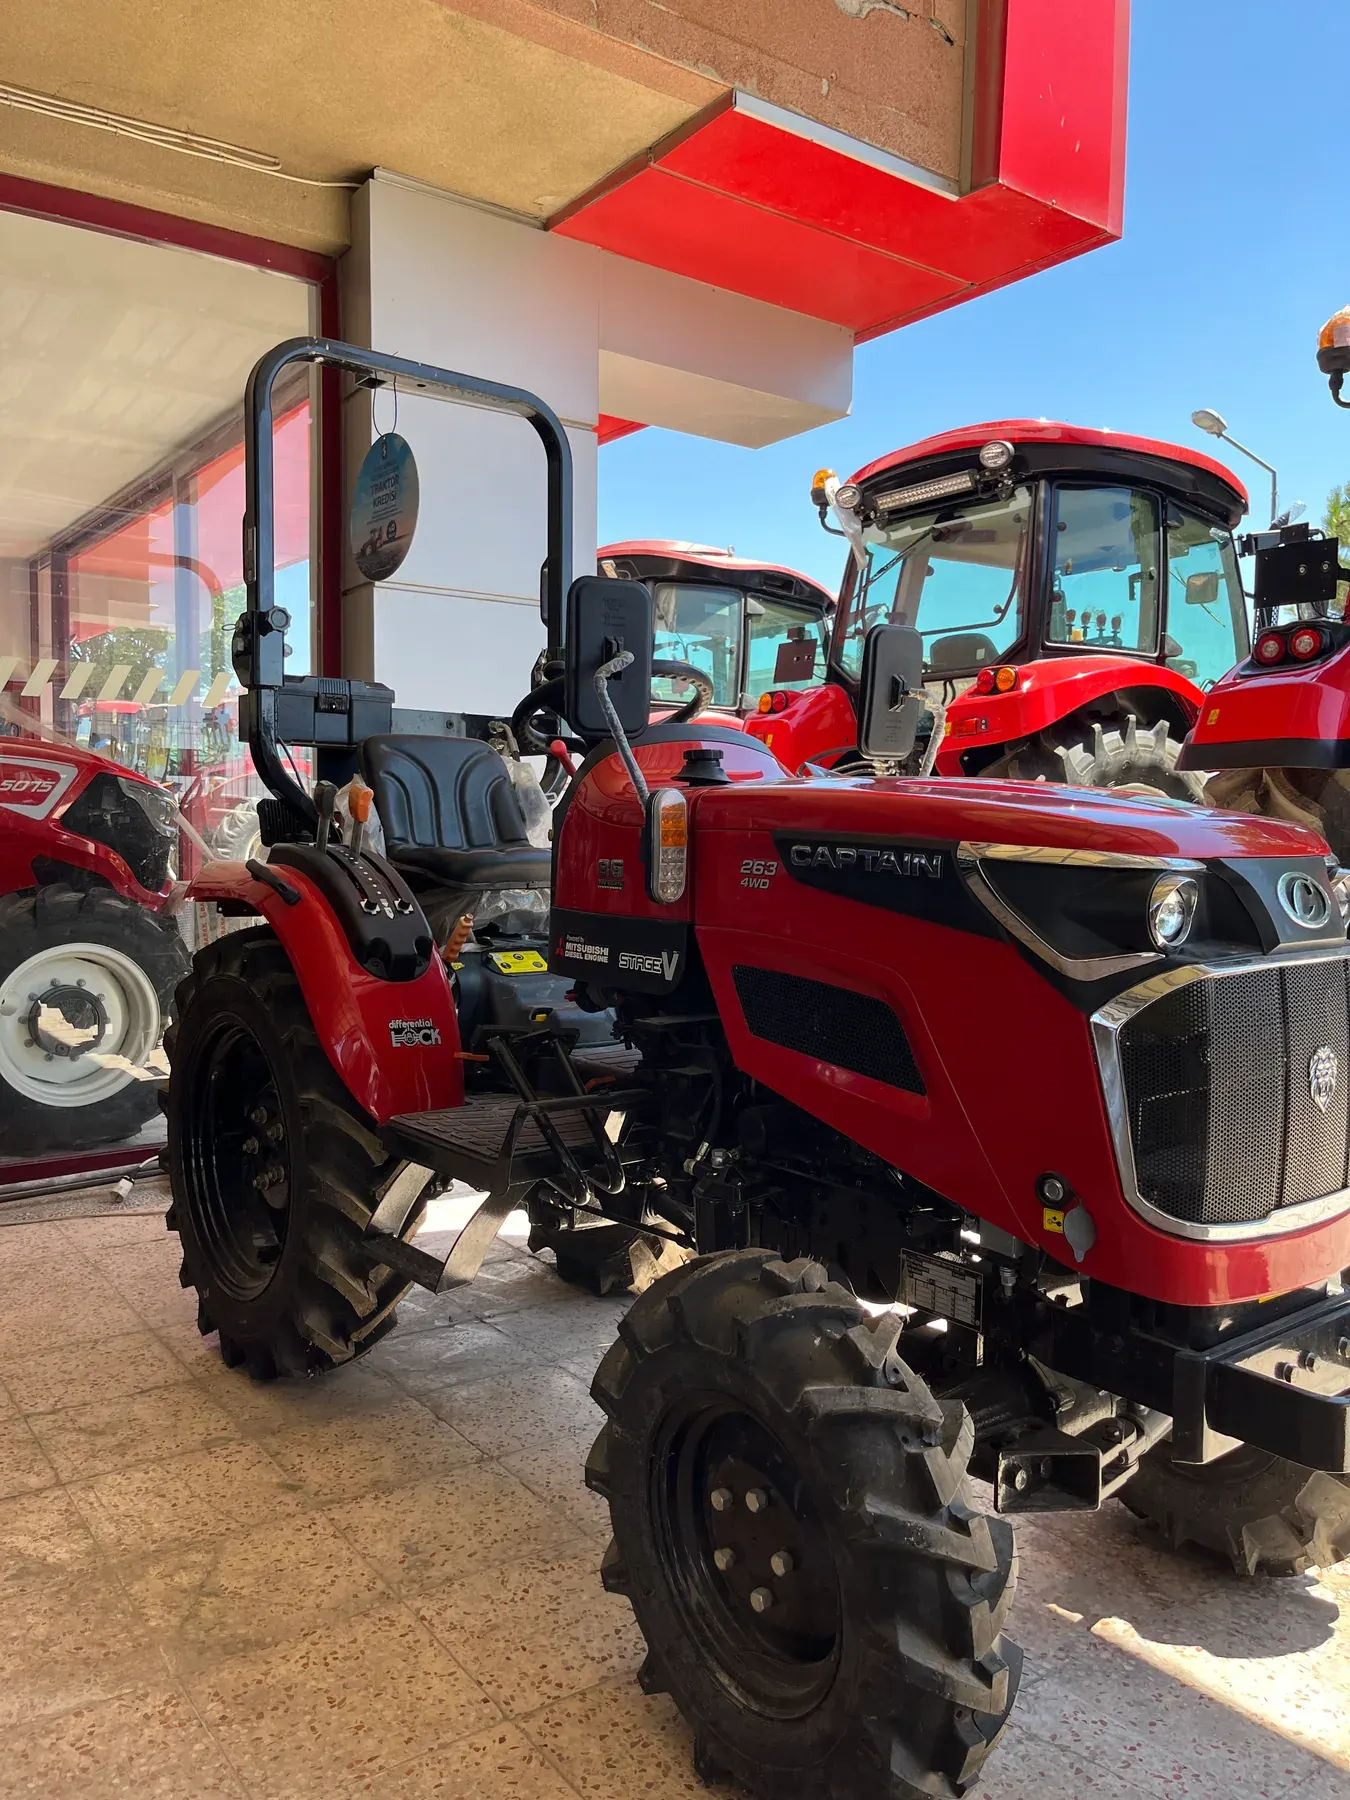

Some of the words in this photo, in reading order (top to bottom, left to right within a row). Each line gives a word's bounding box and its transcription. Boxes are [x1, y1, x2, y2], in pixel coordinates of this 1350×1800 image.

[0, 780, 56, 793] 5075
[740, 859, 777, 876] 263
[790, 845, 942, 879] CAPTAIN
[740, 877, 770, 890] 4WD
[565, 942, 609, 956] MITSUBISHI
[564, 950, 583, 960] DIESEL
[584, 953, 609, 964] ENGINE
[618, 952, 662, 974] STAGE
[661, 950, 680, 981] V
[388, 1018, 433, 1029] differential
[390, 1028, 442, 1048] LOCK
